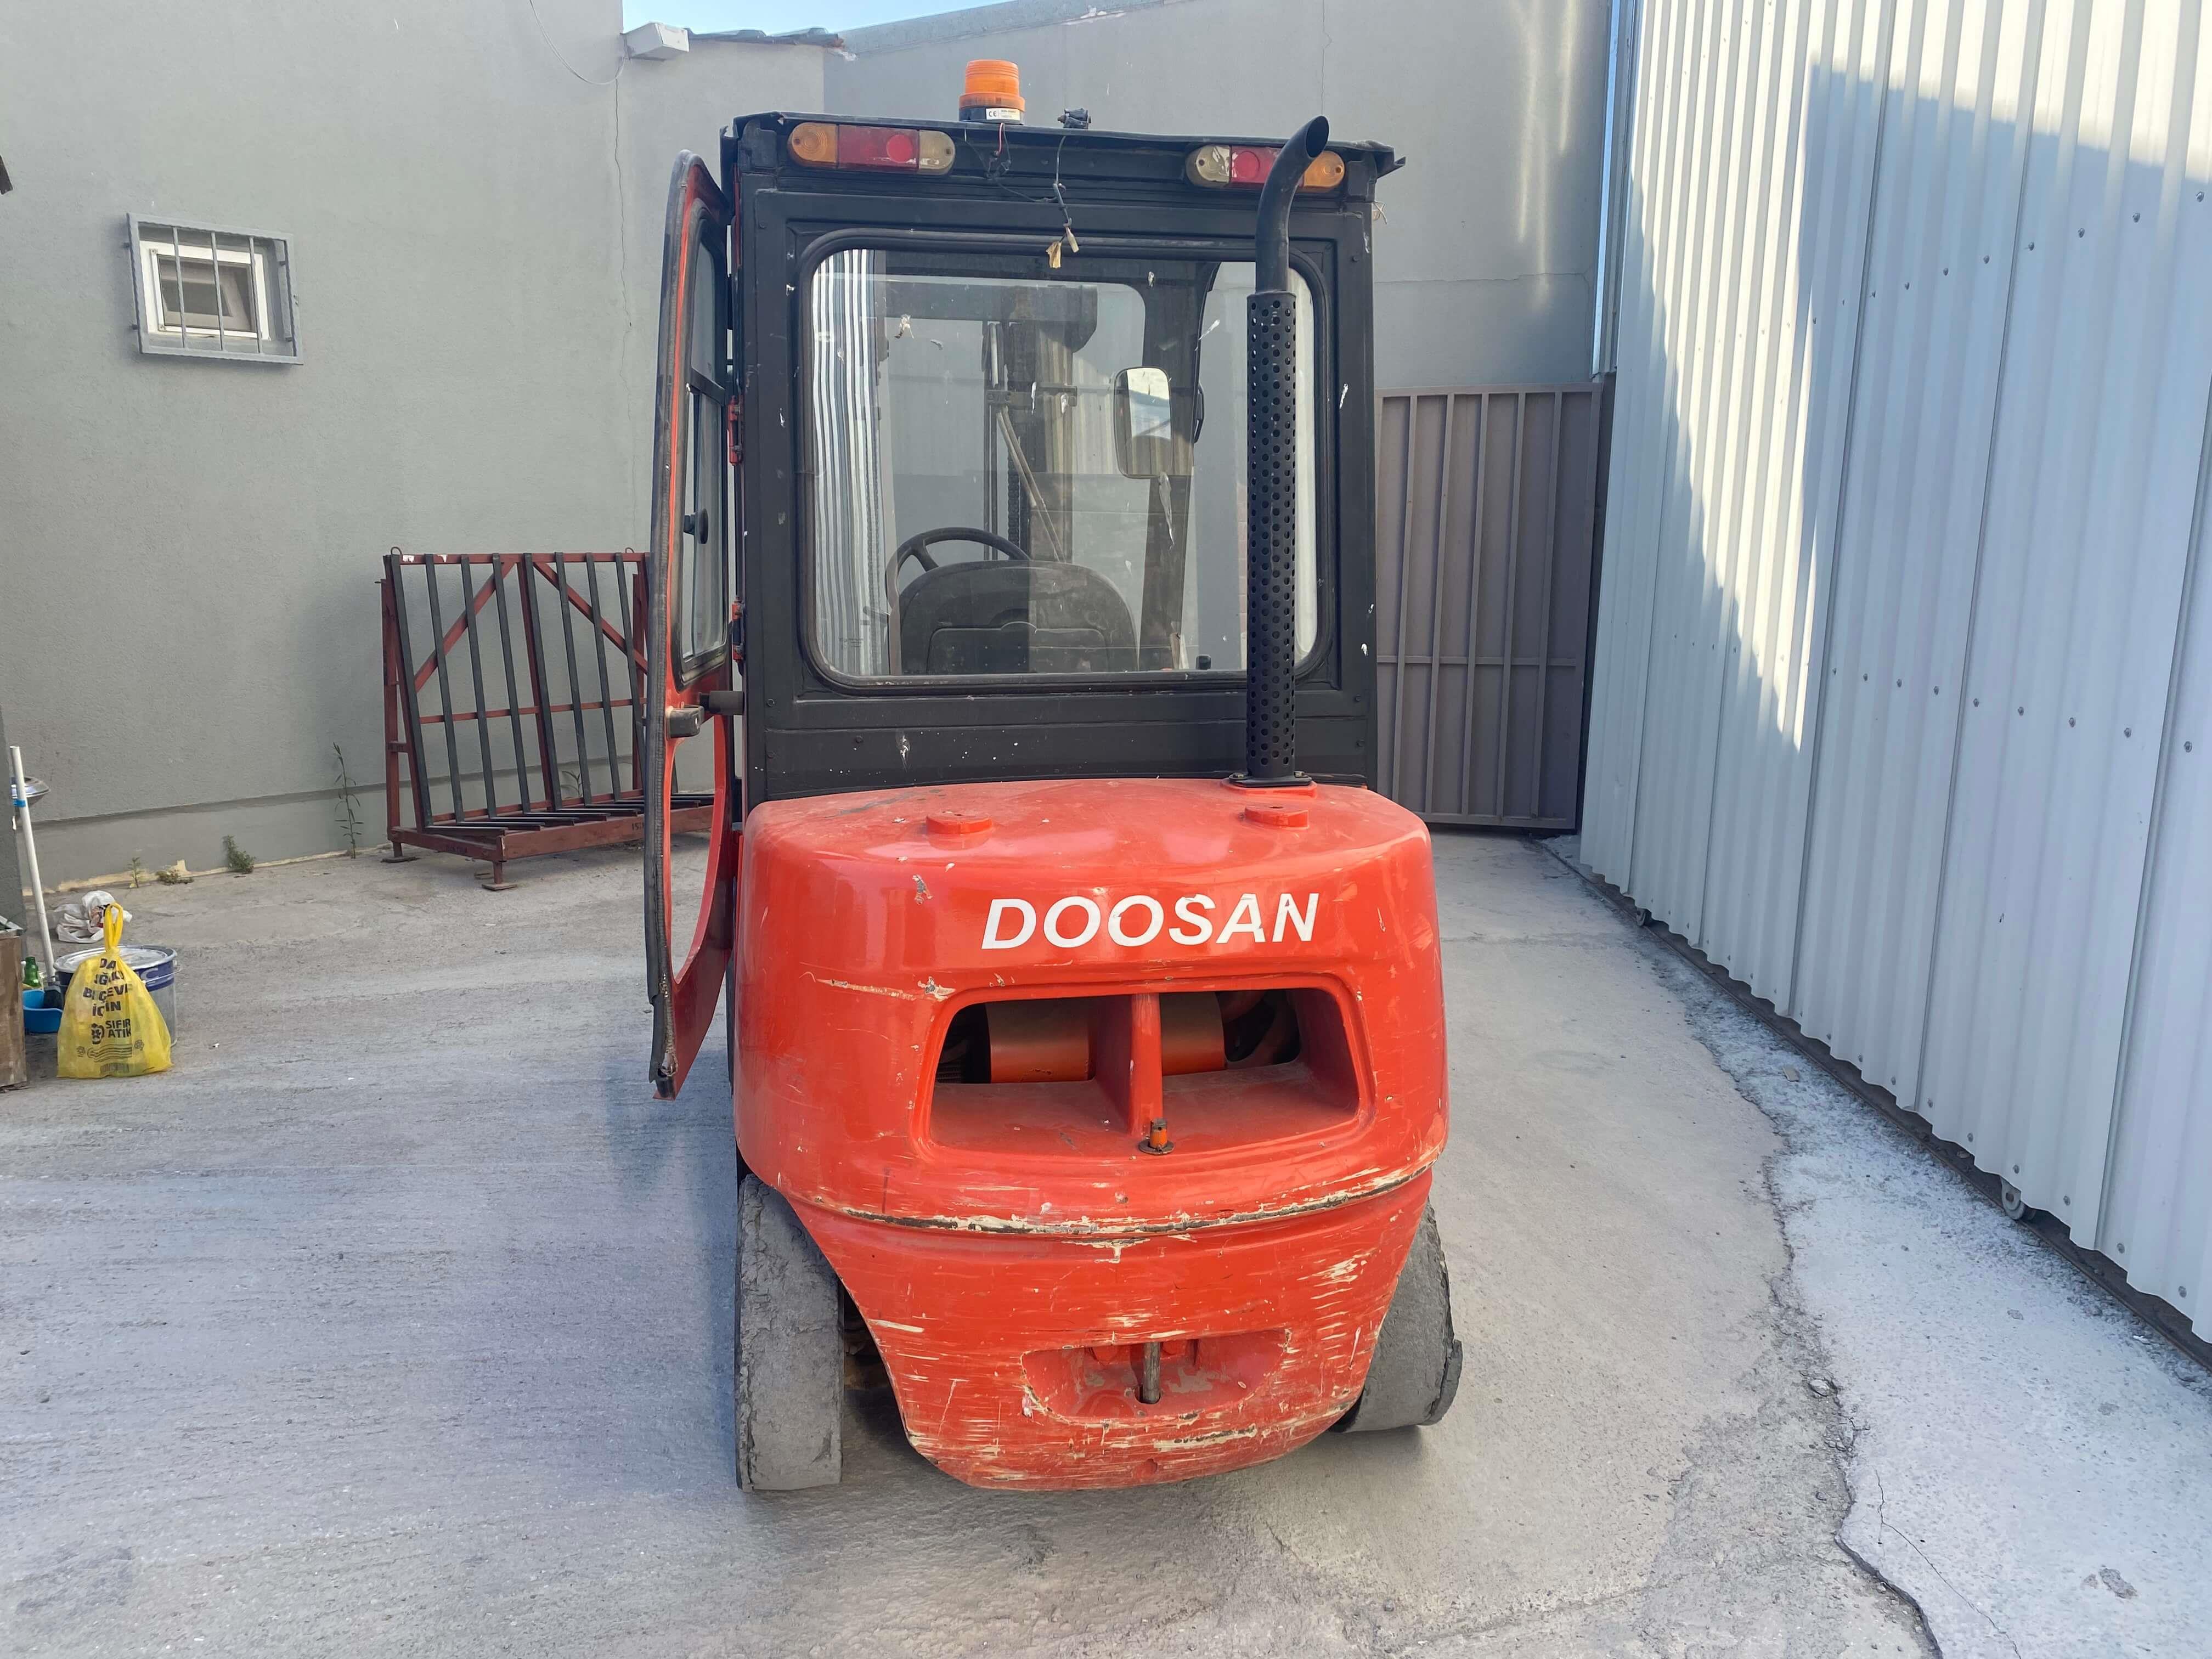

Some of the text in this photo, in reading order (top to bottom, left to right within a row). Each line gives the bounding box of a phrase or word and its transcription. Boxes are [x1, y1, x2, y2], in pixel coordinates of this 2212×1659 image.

[980, 893, 1319, 950] DOOSAN
[105, 1018, 131, 1029] SIFIR
[108, 1028, 131, 1038] ATIK
